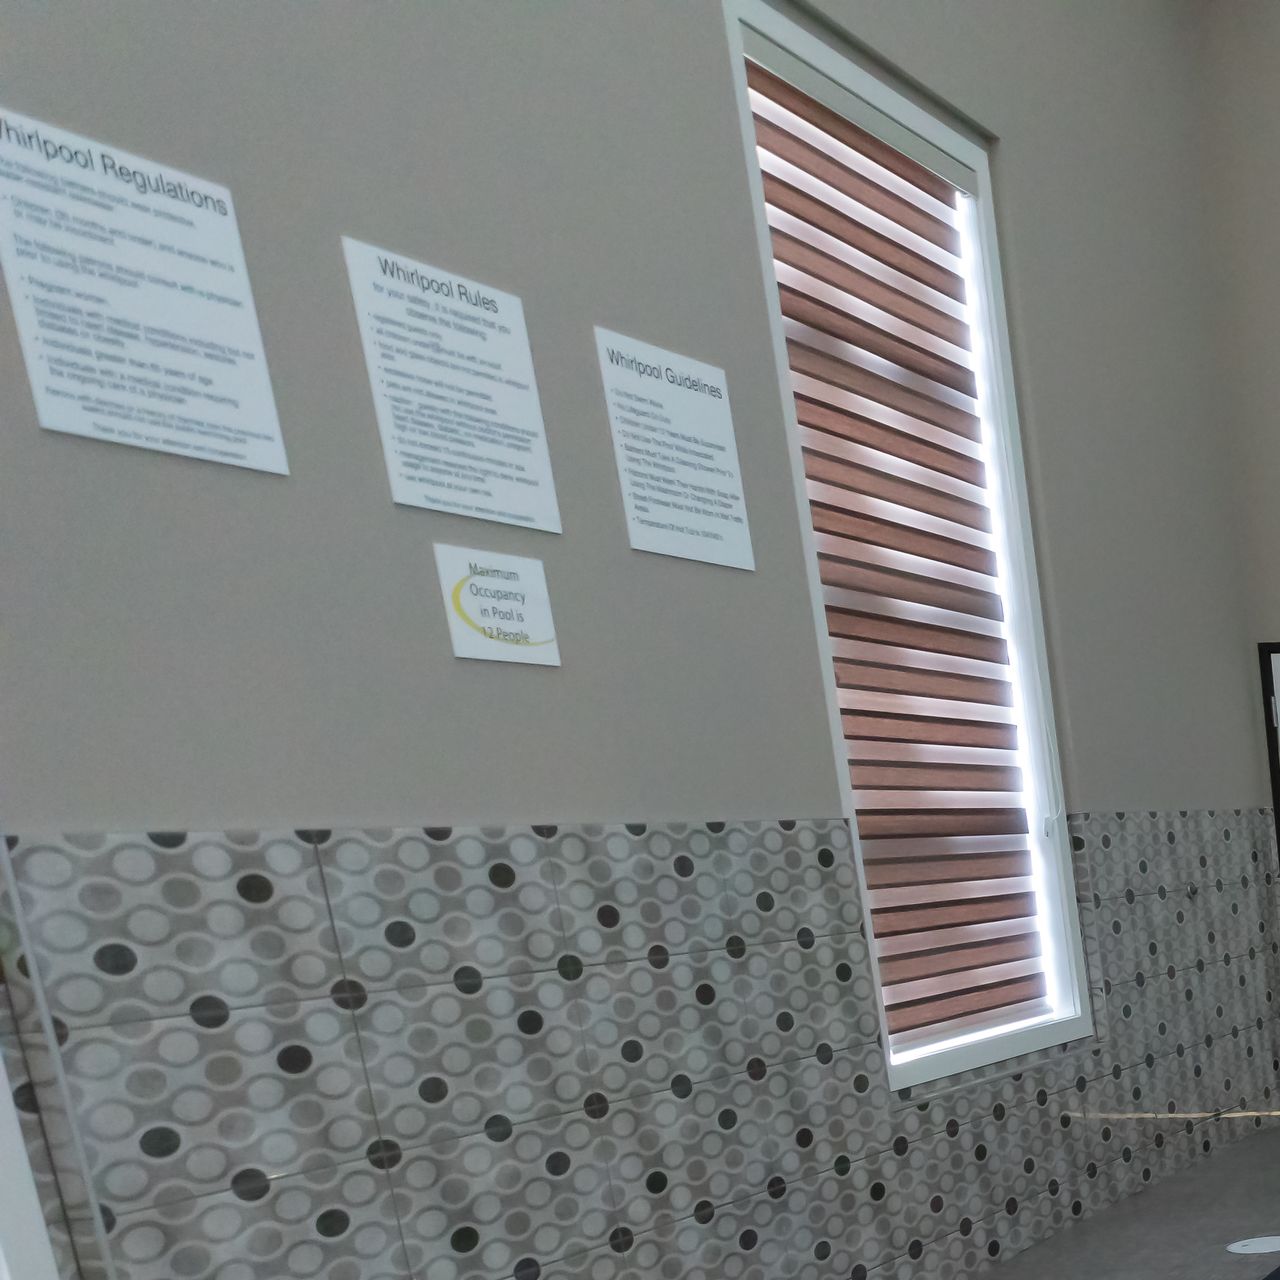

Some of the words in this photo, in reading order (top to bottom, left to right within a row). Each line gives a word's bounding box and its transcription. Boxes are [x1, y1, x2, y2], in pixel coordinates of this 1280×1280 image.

[0, 117, 95, 172] hirlpool
[101, 152, 229, 217] Regulations
[378, 255, 454, 298] Whirlpool
[457, 284, 499, 314] Rules
[606, 347, 662, 380] Whirlpool
[665, 366, 723, 400] Guidelines
[468, 562, 520, 582] Maximum
[469, 583, 526, 606] Occupancy
[480, 608, 490, 618] in
[493, 606, 514, 622] Pool
[516, 610, 525, 623] is
[482, 626, 496, 639] 12
[496, 627, 531, 645] People
